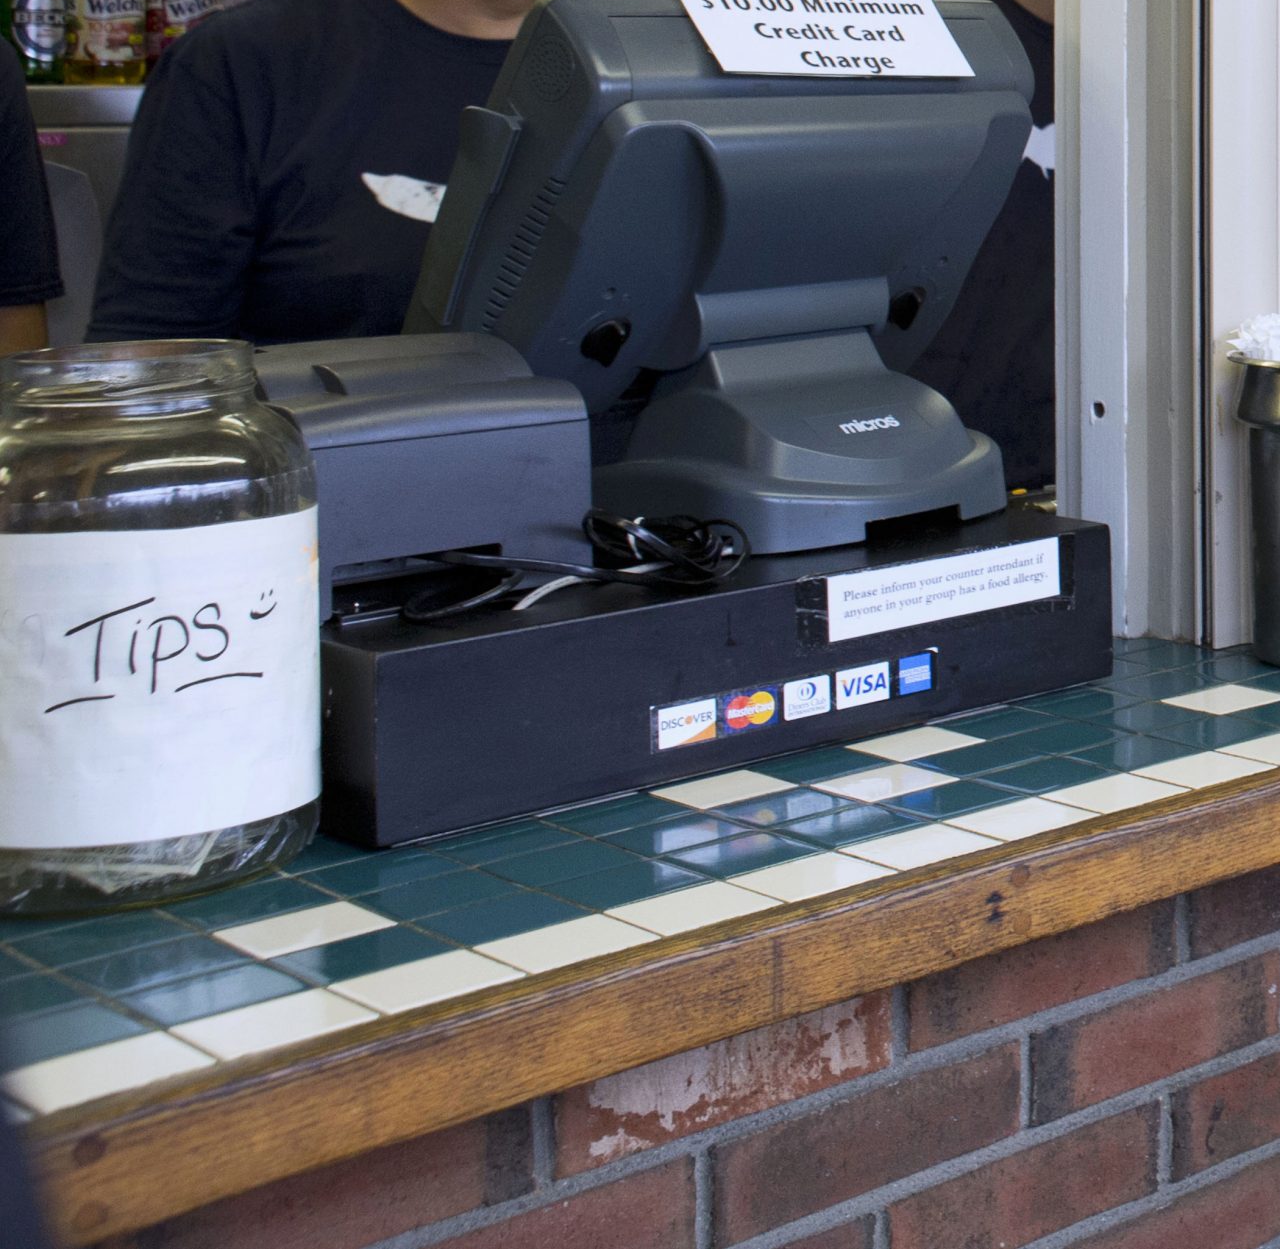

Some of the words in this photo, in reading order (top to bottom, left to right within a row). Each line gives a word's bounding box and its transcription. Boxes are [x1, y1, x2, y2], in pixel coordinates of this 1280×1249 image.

[754, 22, 840, 41] Credit
[842, 24, 906, 42] Card
[800, 50, 896, 74] Charge
[838, 414, 901, 435] micros
[843, 589, 878, 602] Please
[881, 580, 917, 595] inform
[919, 576, 943, 591] your
[945, 567, 985, 583] counter
[986, 557, 1034, 575] attendant
[1035, 552, 1045, 564] if
[843, 605, 882, 620] anyone
[885, 599, 896, 610] in
[898, 594, 923, 614] your
[925, 588, 957, 606] group
[958, 583, 977, 597] has
[978, 584, 986, 592] a
[987, 576, 1011, 590] food
[1012, 569, 1049, 586] allergy.
[841, 671, 887, 698] VISA
[660, 710, 714, 732] DISCOVER
[726, 701, 775, 720] MasterCard
